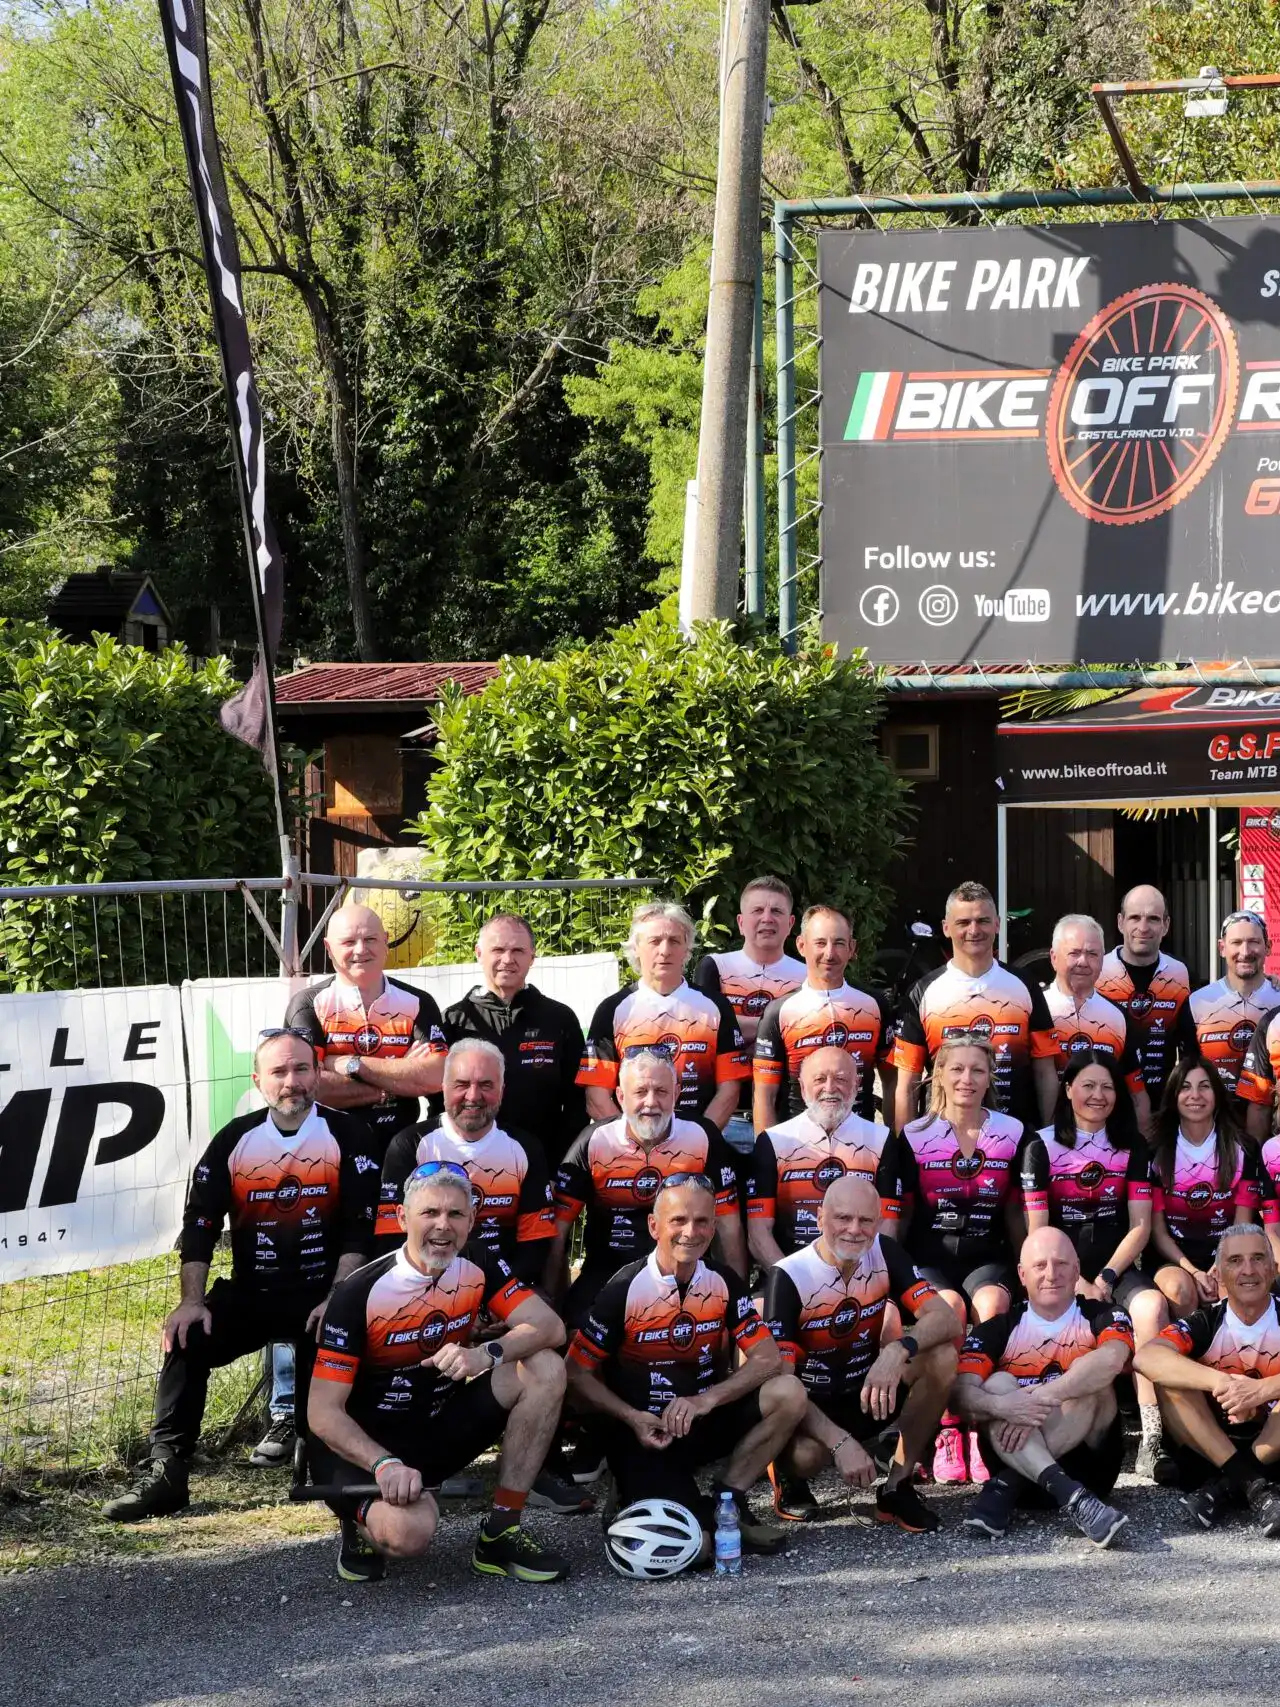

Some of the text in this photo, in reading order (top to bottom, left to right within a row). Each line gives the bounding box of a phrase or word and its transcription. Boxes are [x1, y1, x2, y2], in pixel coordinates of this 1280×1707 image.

[849, 257, 1091, 314] BIKE PARK
[1102, 355, 1201, 372] BIKE PARK
[895, 380, 1050, 429] BIKE
[1071, 374, 1216, 426] OFF
[1078, 428, 1194, 440] CASTELFRANCO V.TO
[865, 545, 996, 569] Follow us:
[975, 594, 1046, 616] YouTube
[1022, 762, 1167, 779] www.bikeoffroad.it
[1210, 768, 1243, 781] Team
[1248, 766, 1277, 779] MTB
[1246, 818, 1268, 826] BIKE
[681, 1043, 707, 1051] ROAD
[637, 1179, 657, 1187] OFF
[256, 1191, 275, 1199] BIKE
[278, 1188, 298, 1197] OFF
[484, 1197, 512, 1205] ROAD
[394, 1314, 472, 1343] BIKE OFF ROAD
[807, 1317, 833, 1329] BIKE
[835, 1313, 856, 1324] OFF
[644, 1331, 669, 1342] BIKE
[673, 1326, 692, 1336] OFF
